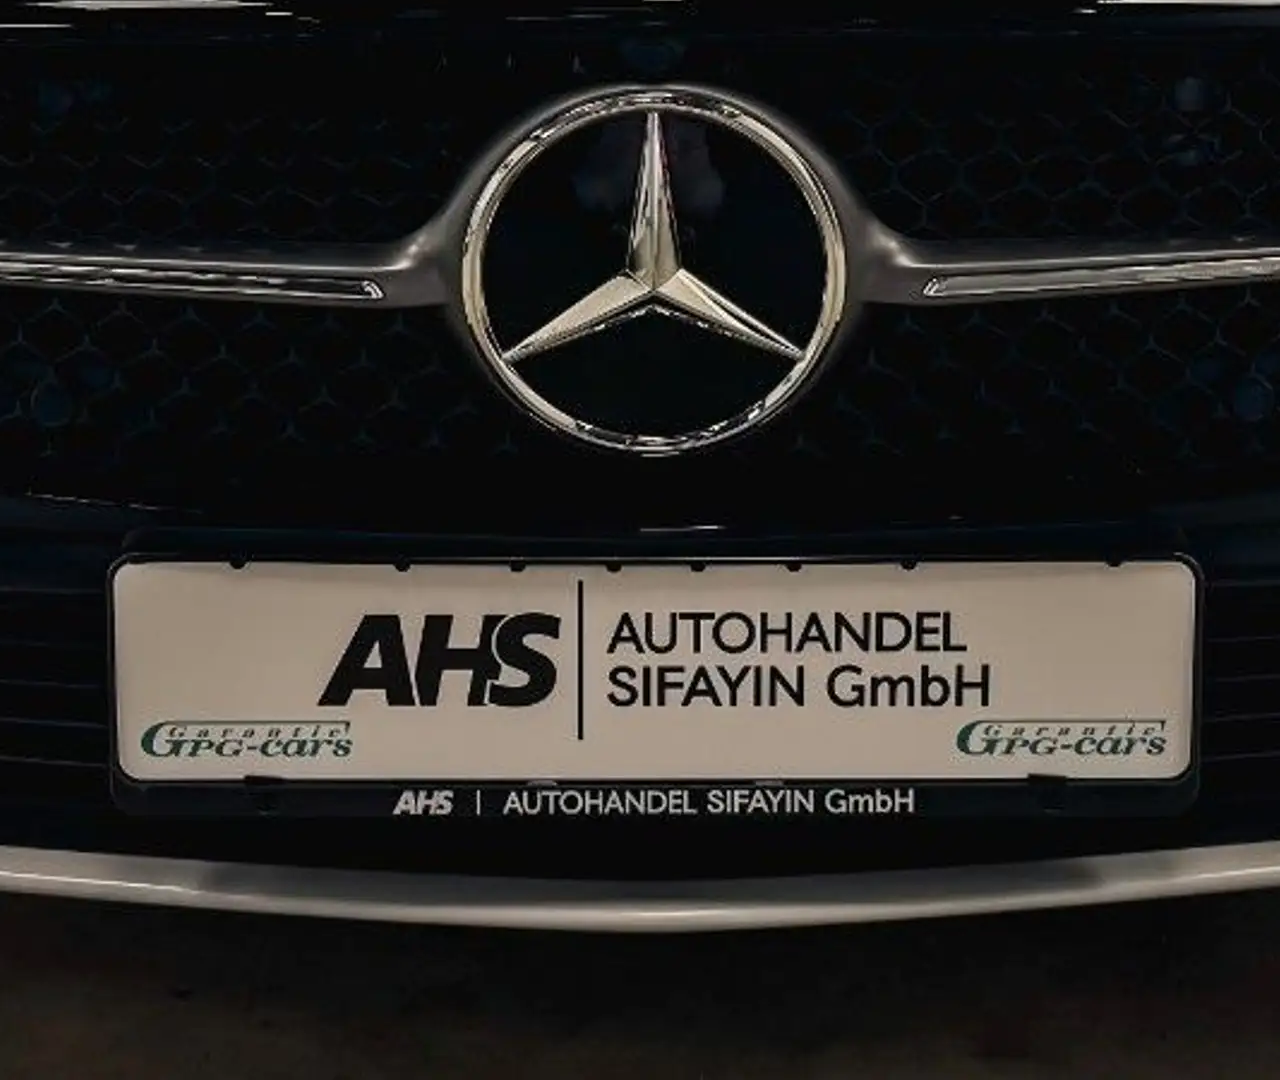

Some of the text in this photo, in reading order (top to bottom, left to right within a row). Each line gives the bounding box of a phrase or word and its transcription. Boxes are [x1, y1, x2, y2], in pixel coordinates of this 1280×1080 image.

[607, 612, 967, 654] AUTOHANDEL
[318, 613, 561, 707] AHS
[607, 664, 990, 707] SIFAYIN GmbH
[393, 788, 915, 815] AHS AUTOHANDEL SIFAYIN GmbH
